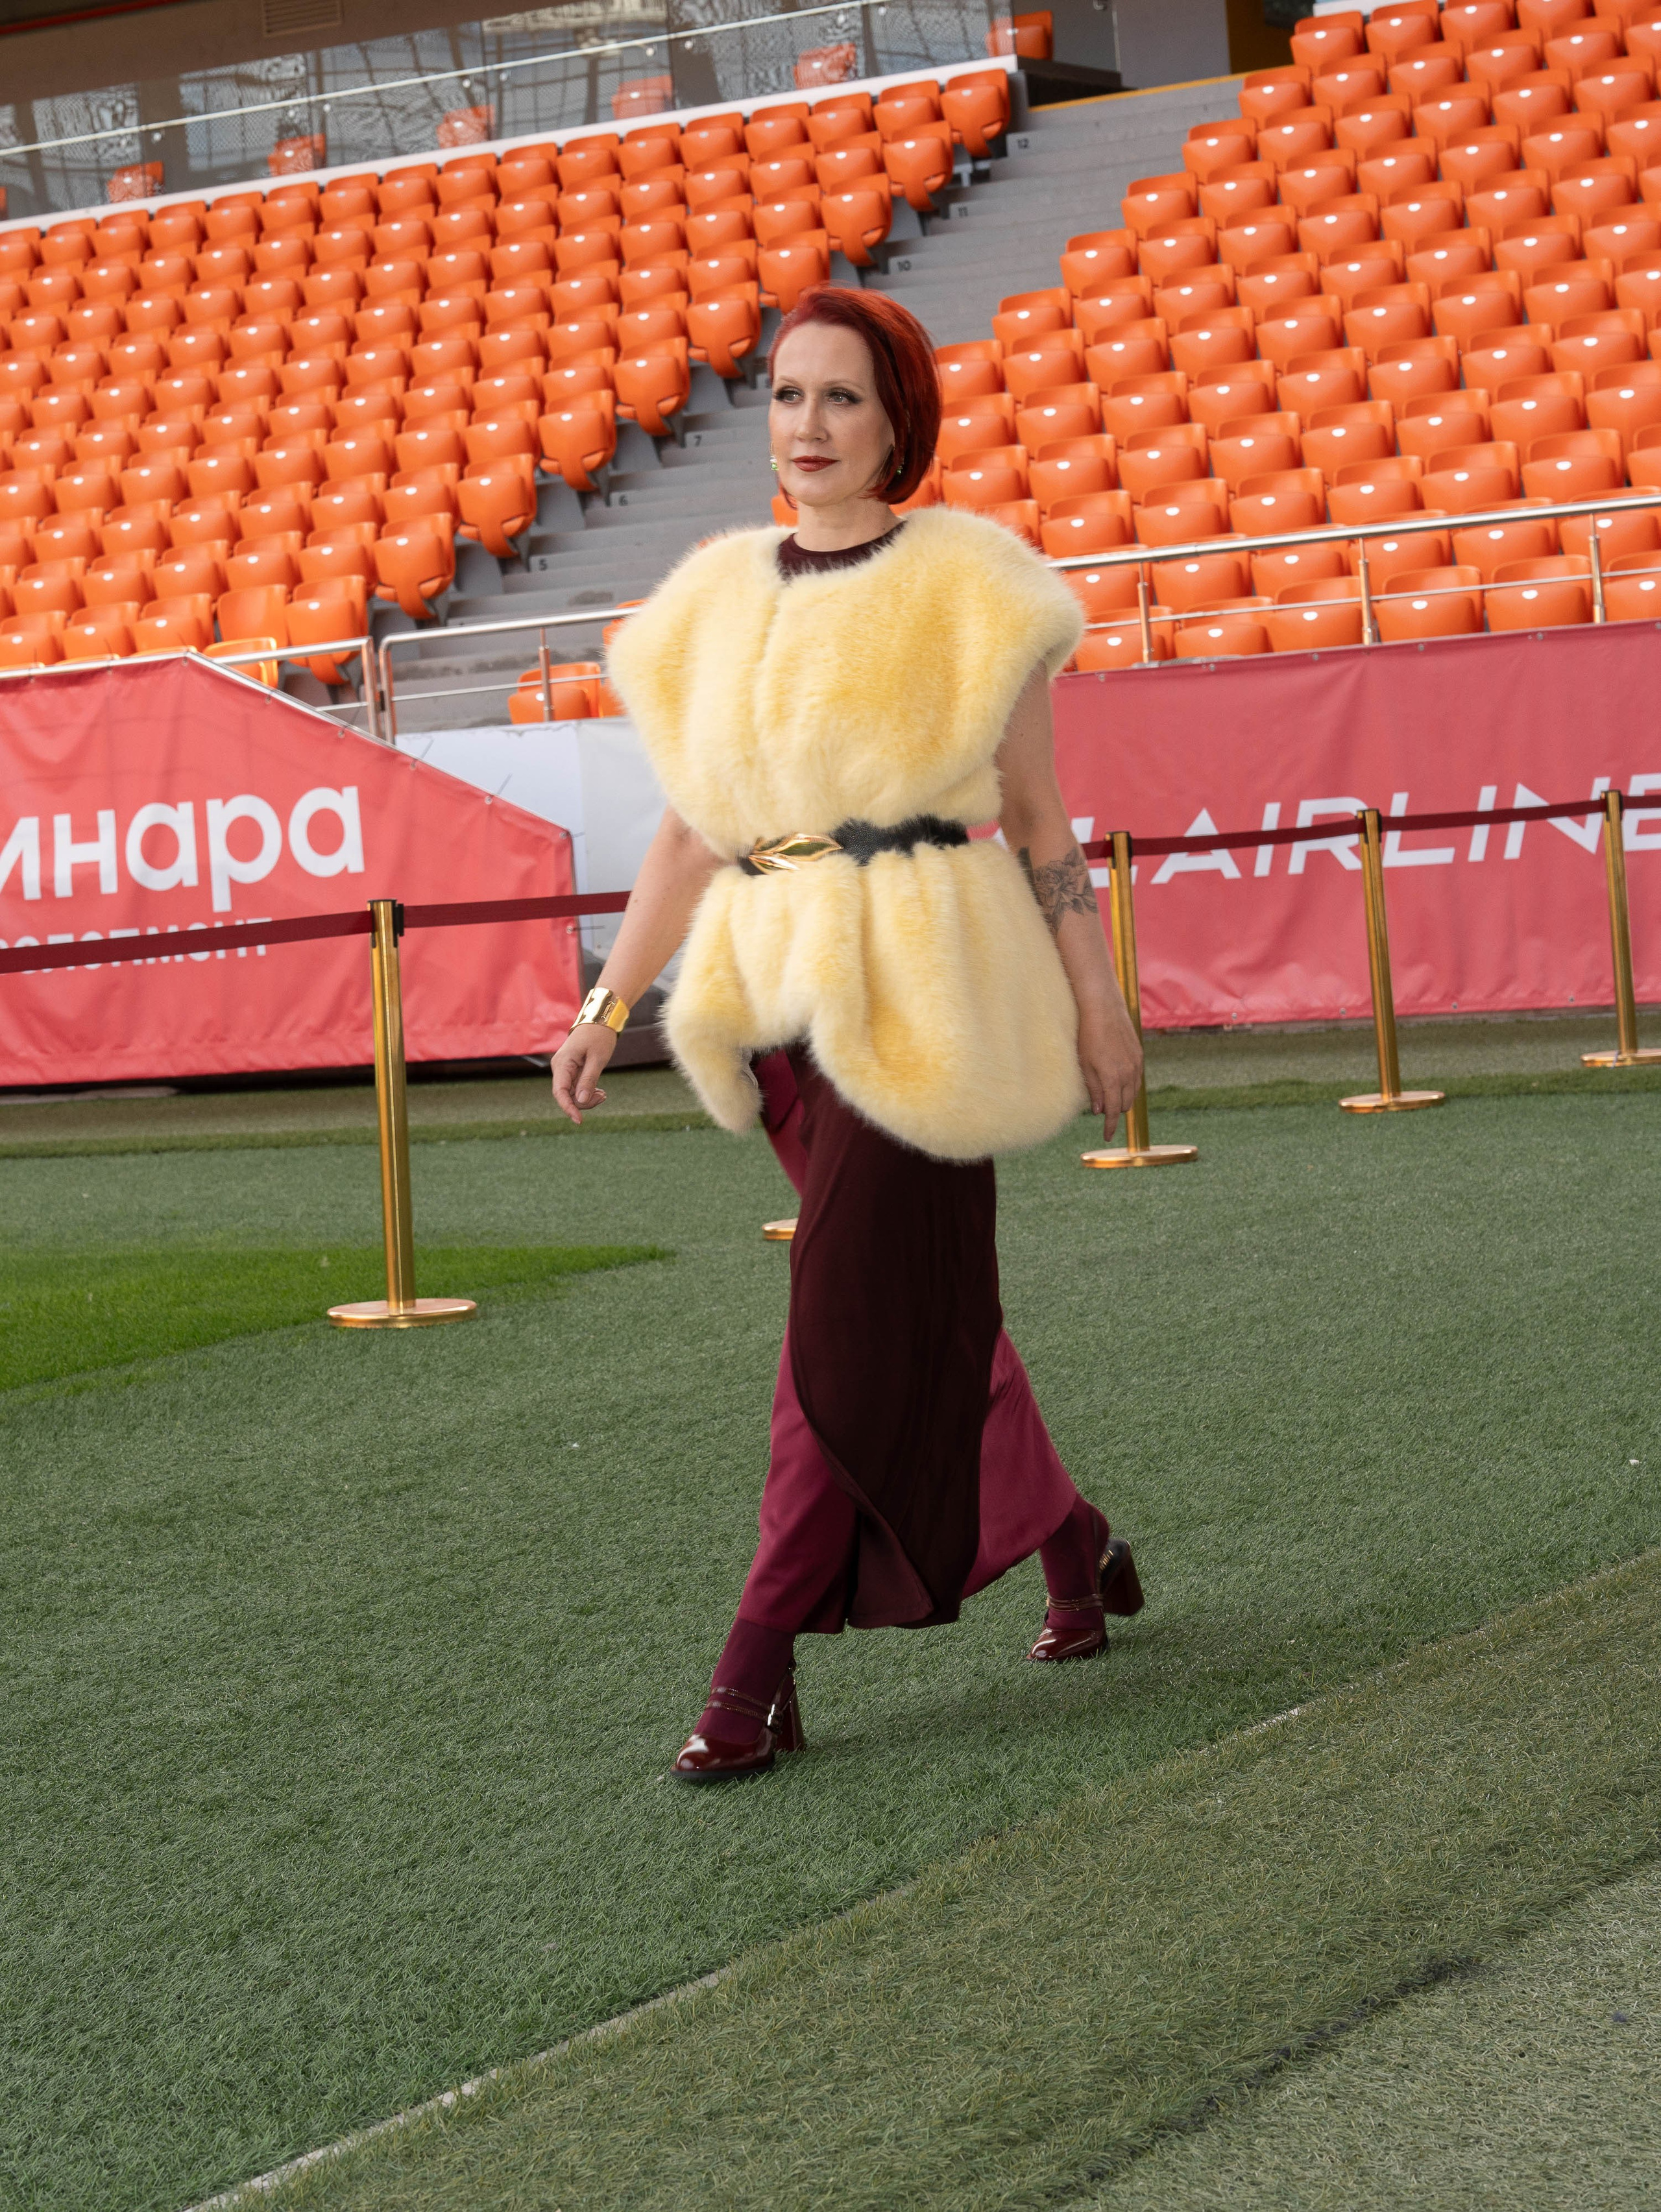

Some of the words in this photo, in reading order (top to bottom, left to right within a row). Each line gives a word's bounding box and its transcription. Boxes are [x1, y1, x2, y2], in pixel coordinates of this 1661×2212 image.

[1017, 138, 1029, 149] 12
[958, 206, 969, 218] 11
[897, 260, 912, 271] 10
[694, 435, 702, 448] 7
[619, 494, 628, 506] 6
[539, 559, 548, 571] 5
